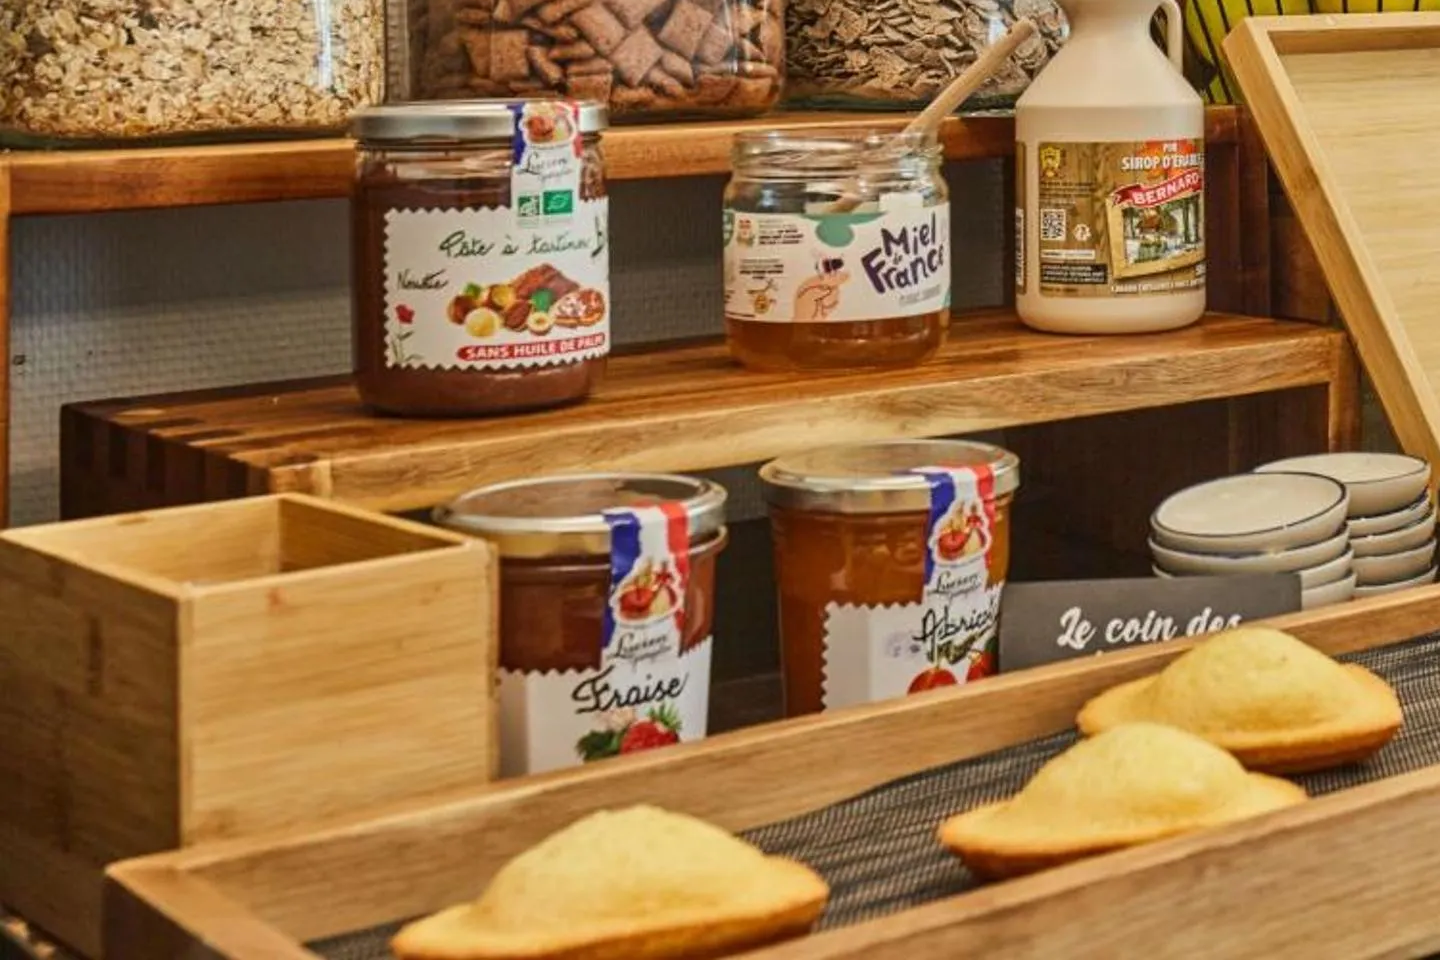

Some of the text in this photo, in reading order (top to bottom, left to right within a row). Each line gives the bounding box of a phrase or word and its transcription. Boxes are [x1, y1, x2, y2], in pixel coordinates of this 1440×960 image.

[1121, 155, 1160, 170] SIROP
[1131, 172, 1200, 205] BERNARD
[881, 210, 936, 257] Miel
[465, 344, 509, 360] SANS
[514, 338, 557, 357] HUILE
[1056, 606, 1097, 650] Le
[1105, 609, 1177, 643] coin
[571, 665, 689, 714] Fraise
